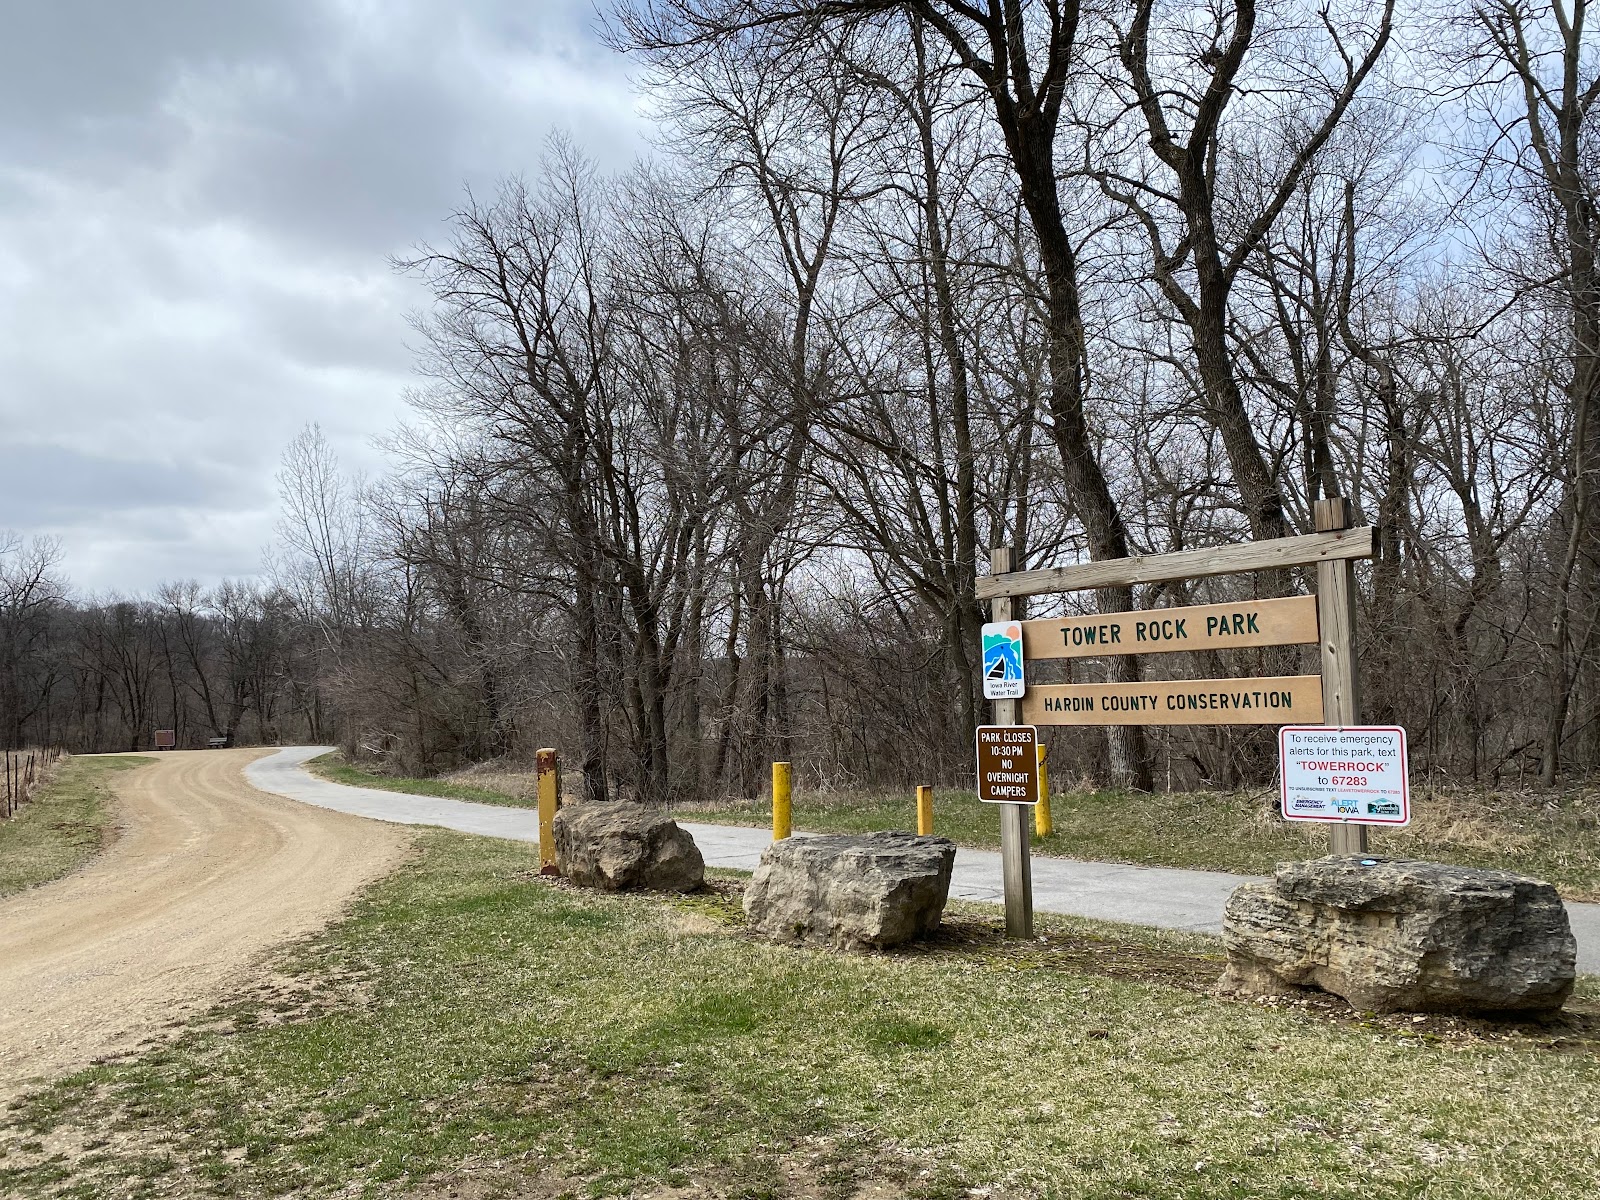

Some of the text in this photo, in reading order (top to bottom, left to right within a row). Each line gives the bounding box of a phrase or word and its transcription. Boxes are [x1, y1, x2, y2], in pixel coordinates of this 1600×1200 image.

[1060, 612, 1260, 646] TOWER ROCK PARK
[1044, 692, 1292, 712] HARDIN COUNTY CONSERVATION
[981, 733, 1032, 742] PARK CLOSES
[1291, 734, 1393, 745] To receive emergency
[991, 746, 1023, 756] 10:30 PM
[1289, 747, 1396, 758] alerts for this park, text
[1002, 759, 1012, 769] NO
[987, 772, 1028, 783] OVERNIGHT
[1318, 776, 1367, 786] to 67283
[991, 786, 1026, 796] CAMPERS
